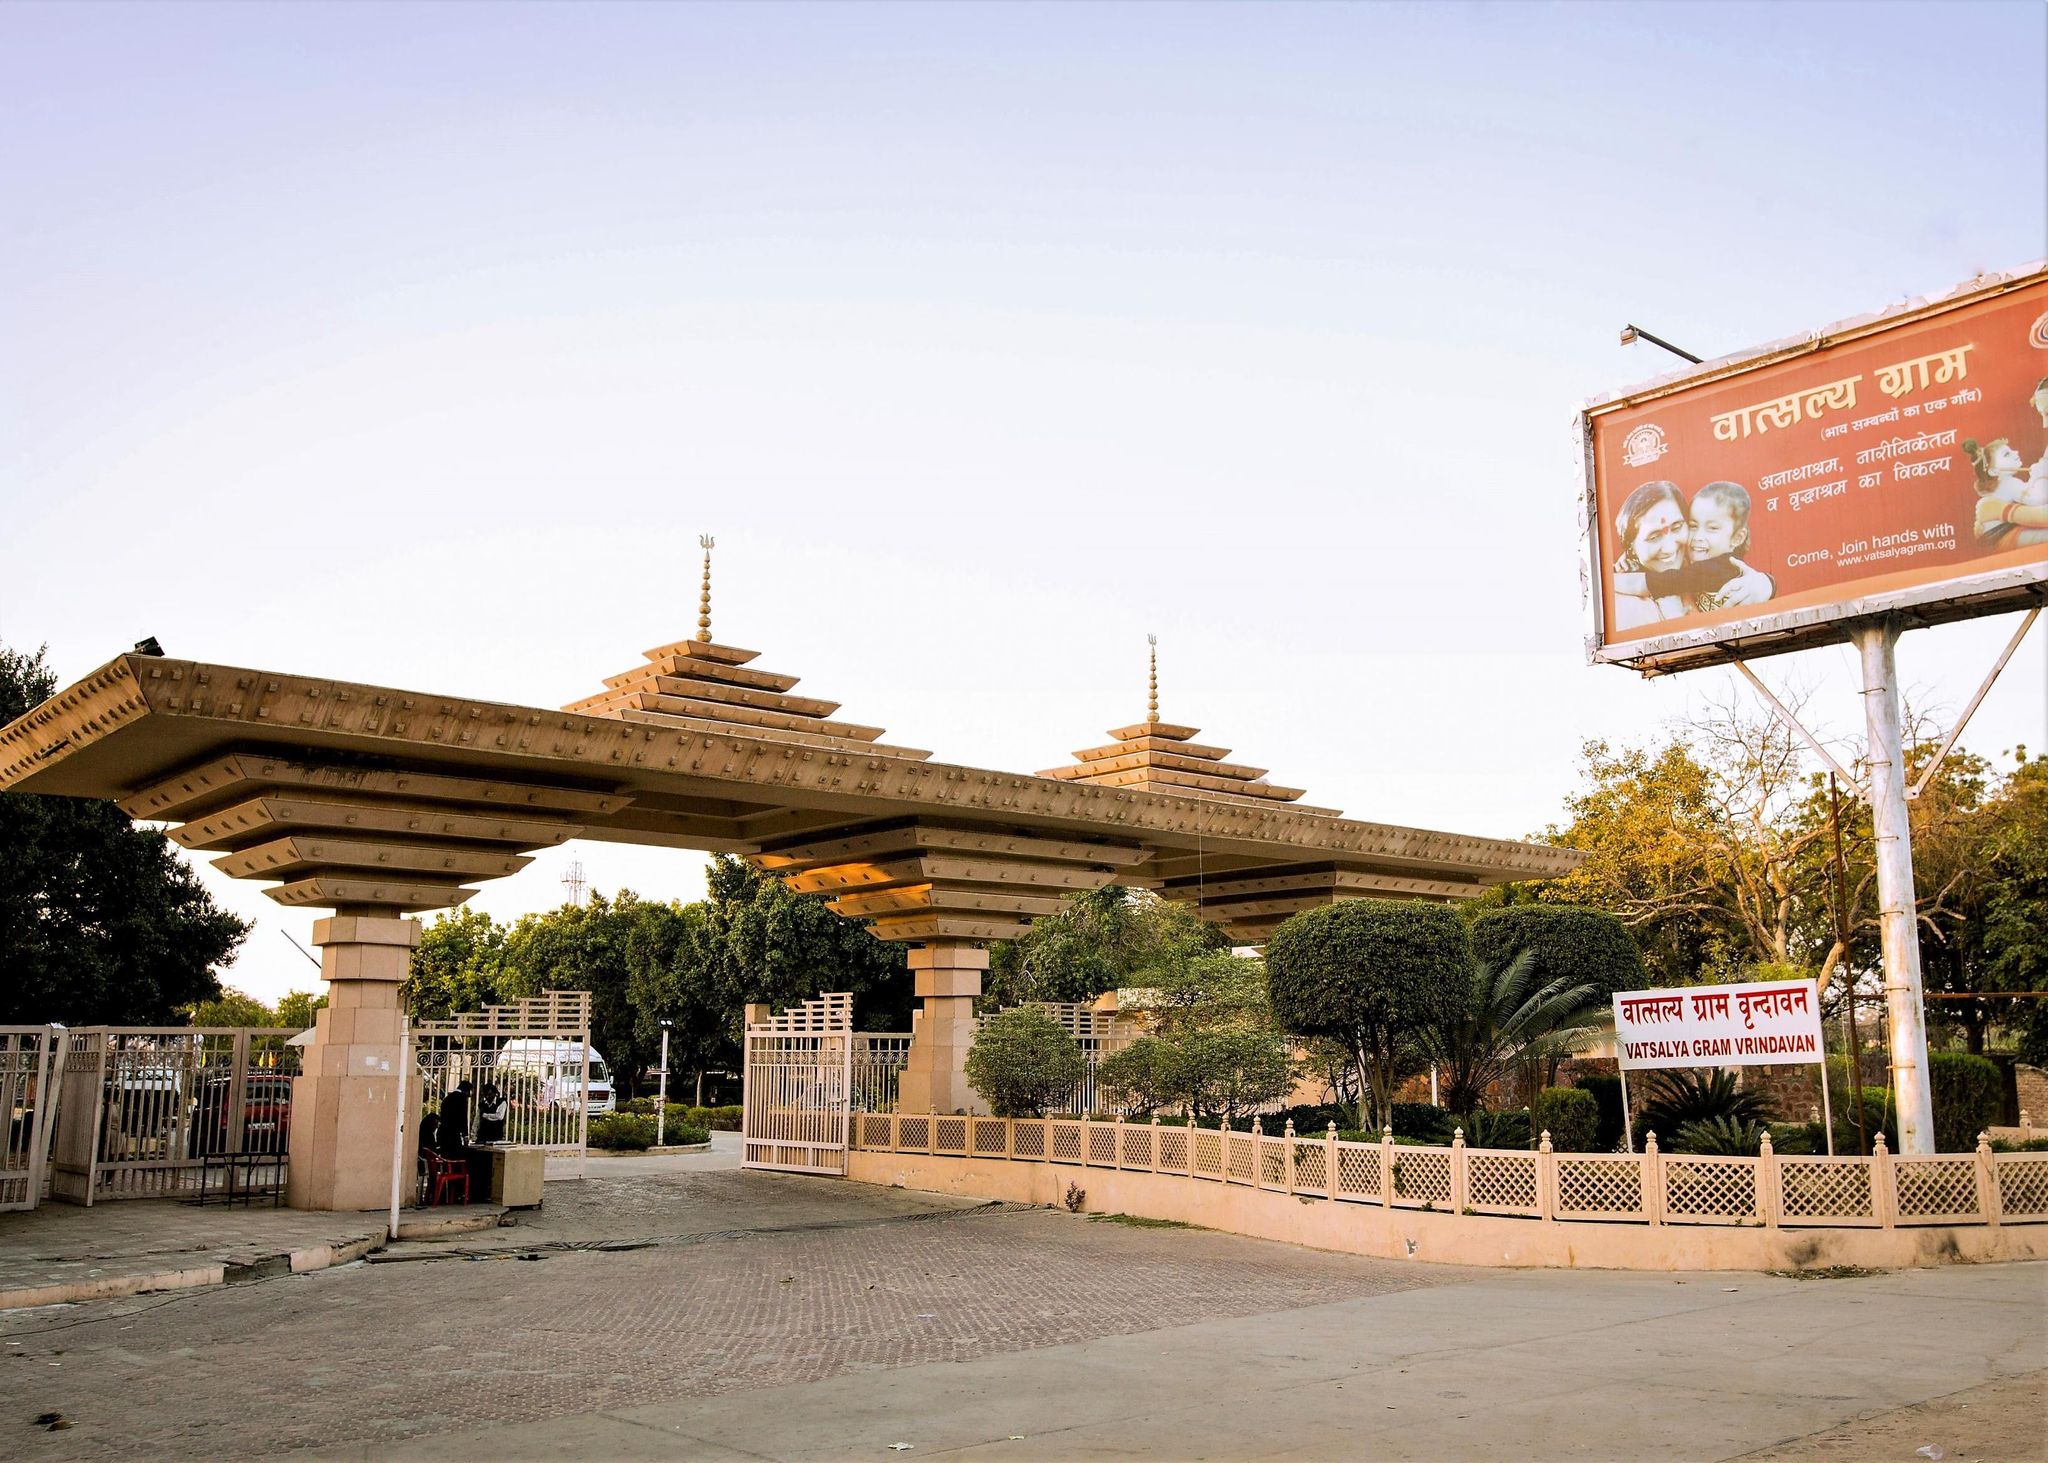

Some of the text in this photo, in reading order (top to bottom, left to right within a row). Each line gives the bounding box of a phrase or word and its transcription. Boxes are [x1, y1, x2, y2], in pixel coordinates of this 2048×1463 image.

[1710, 374, 1863, 442] वात्सल्य
[1874, 344, 1973, 399] ग्राम
[1820, 423, 1848, 441] (भाव
[1903, 404, 1920, 418] का
[1924, 398, 1947, 414] एक
[1758, 429, 1957, 491] अनाथाश्रम, नारीनिकेतन
[1767, 497, 1779, 512] व
[1858, 471, 1882, 489] का
[1893, 456, 1952, 482] विकल्प
[1787, 523, 1954, 567] Come, Join hands with
[1837, 539, 1956, 567] www.vatsalyagram.org
[1620, 987, 1808, 1029] वात्सल्य ग्राम वृन्दावन
[1625, 1034, 1816, 1060] VATSALYA GRAM VRINDAVAN
